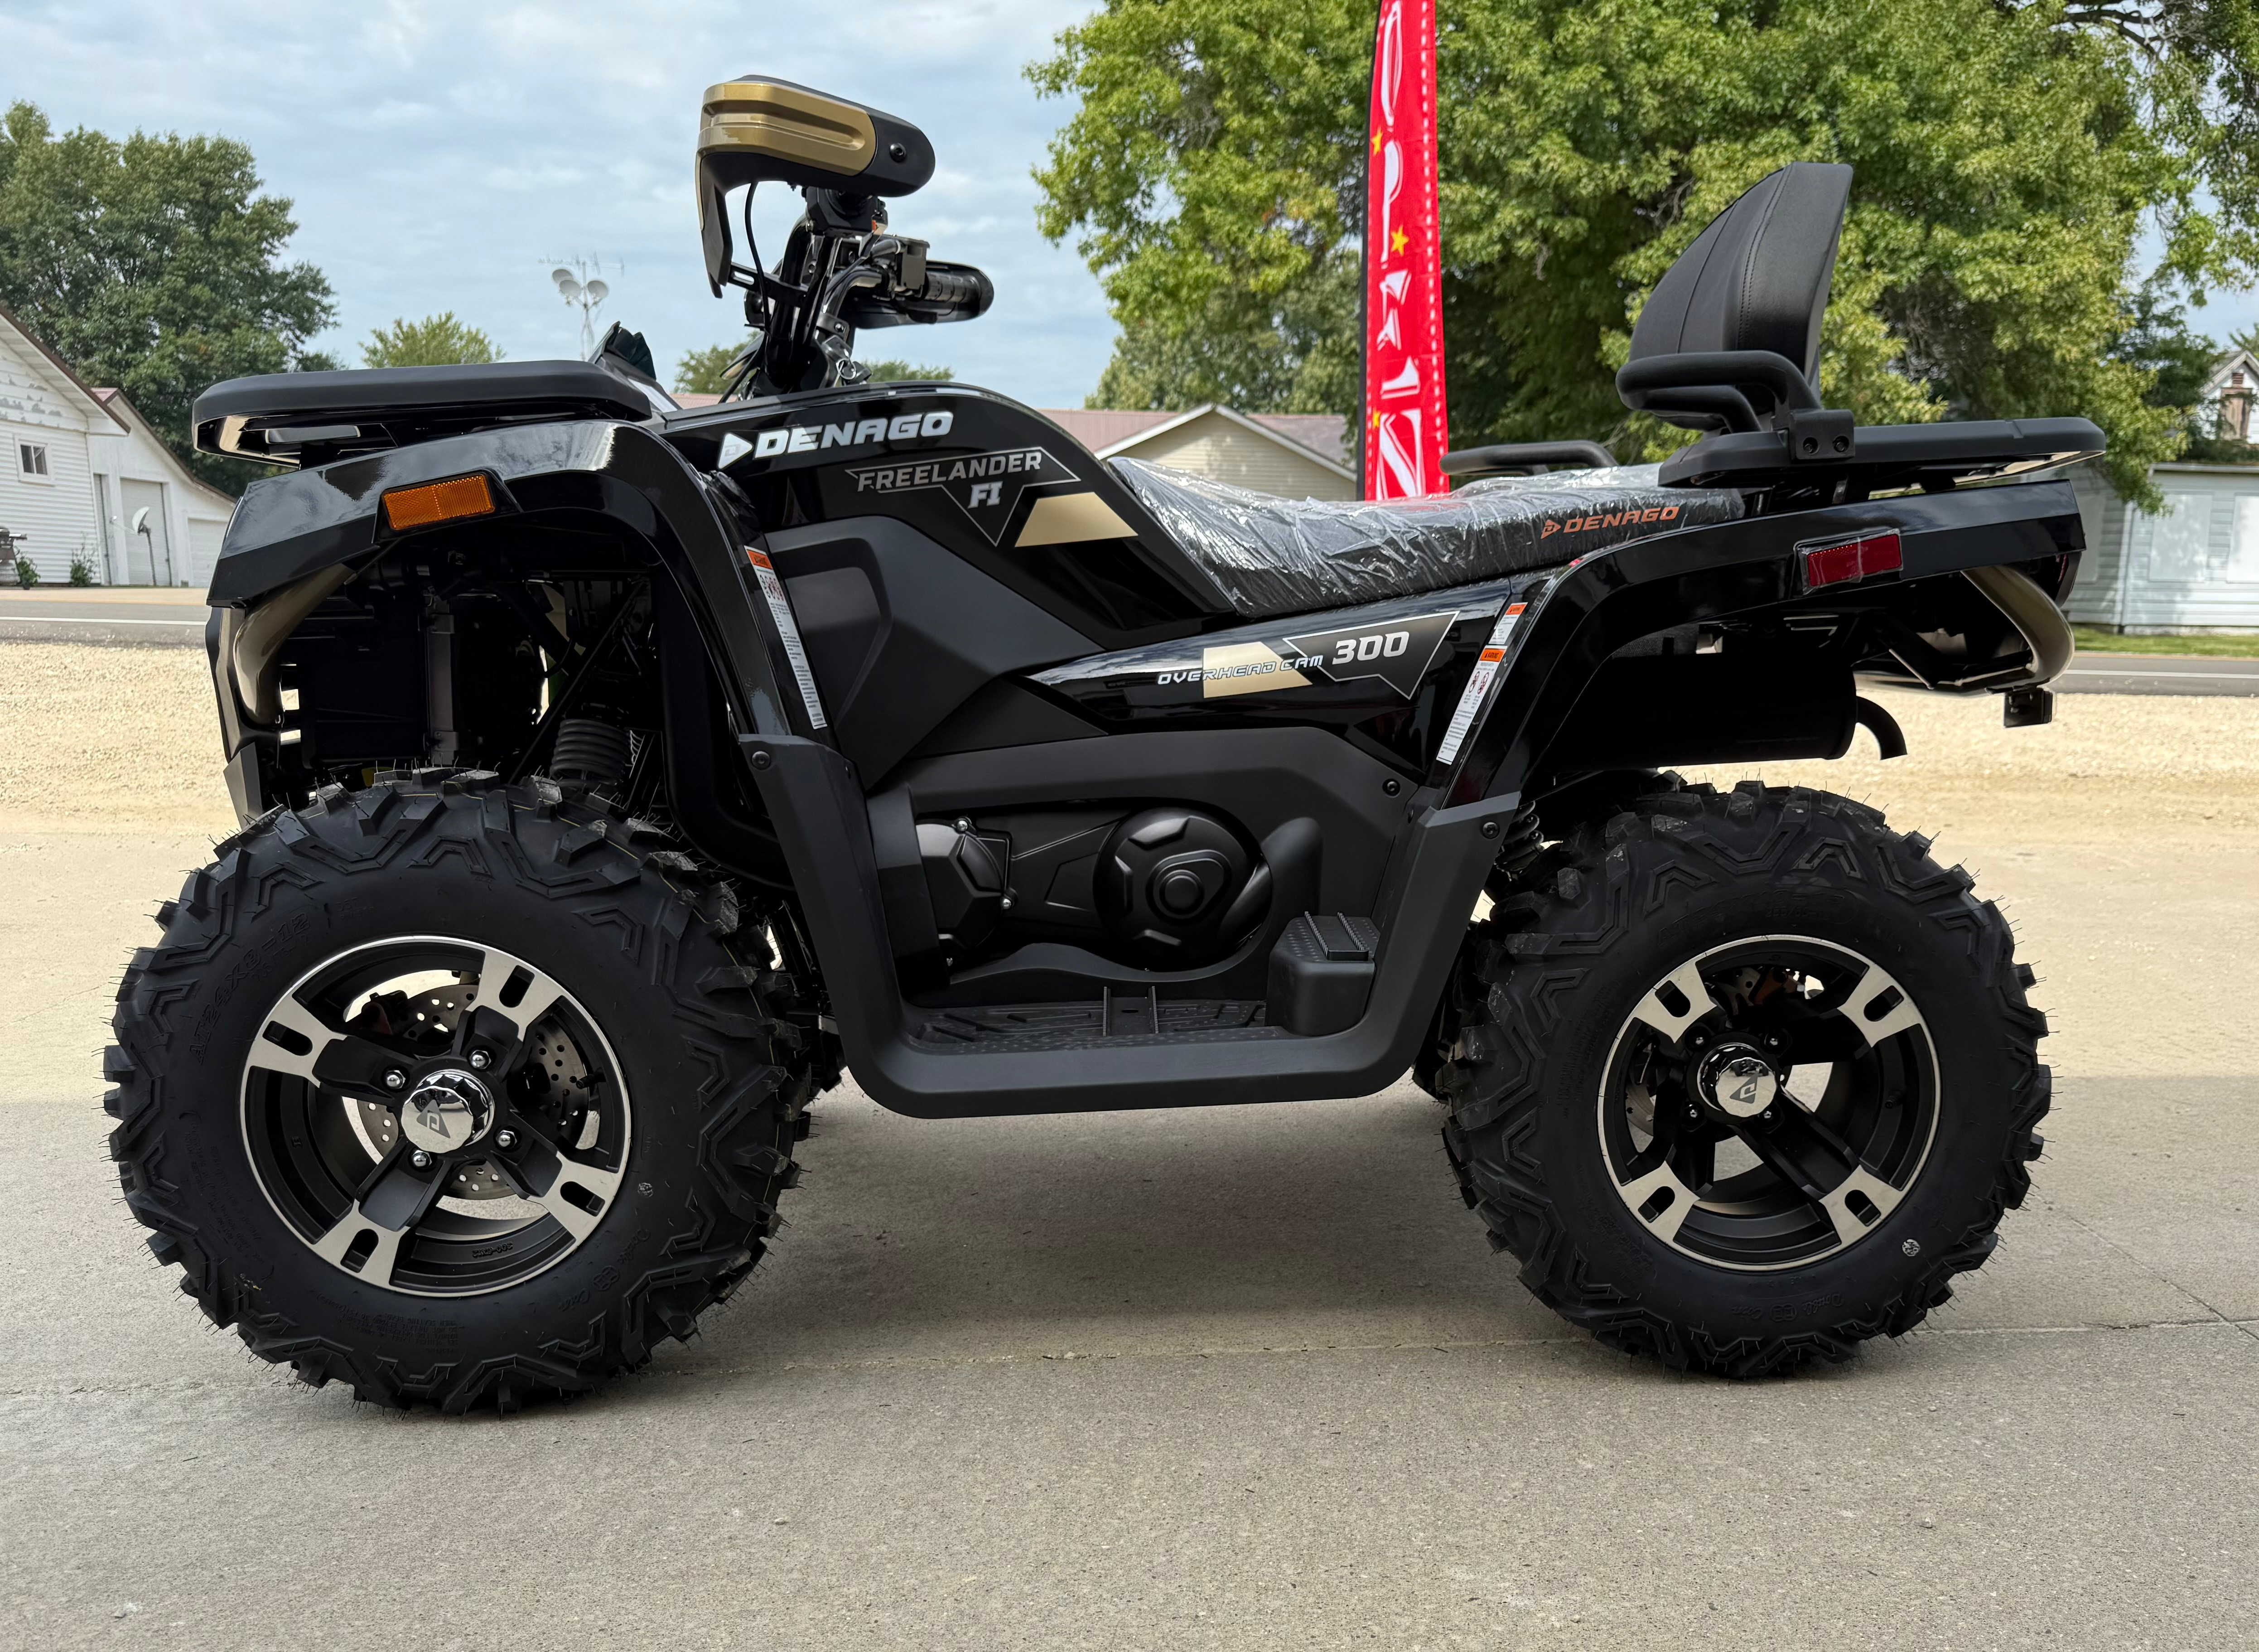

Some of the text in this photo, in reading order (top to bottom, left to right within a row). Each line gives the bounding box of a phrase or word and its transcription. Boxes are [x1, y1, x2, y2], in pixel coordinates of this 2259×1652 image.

[753, 410, 954, 459] DENAGO
[857, 451, 1043, 493] FREELANDER
[968, 481, 1003, 510] FI
[1563, 506, 1680, 533] DENAGO
[1332, 631, 1410, 665] 300
[1157, 655, 1324, 685] OVERHEAD CAM
